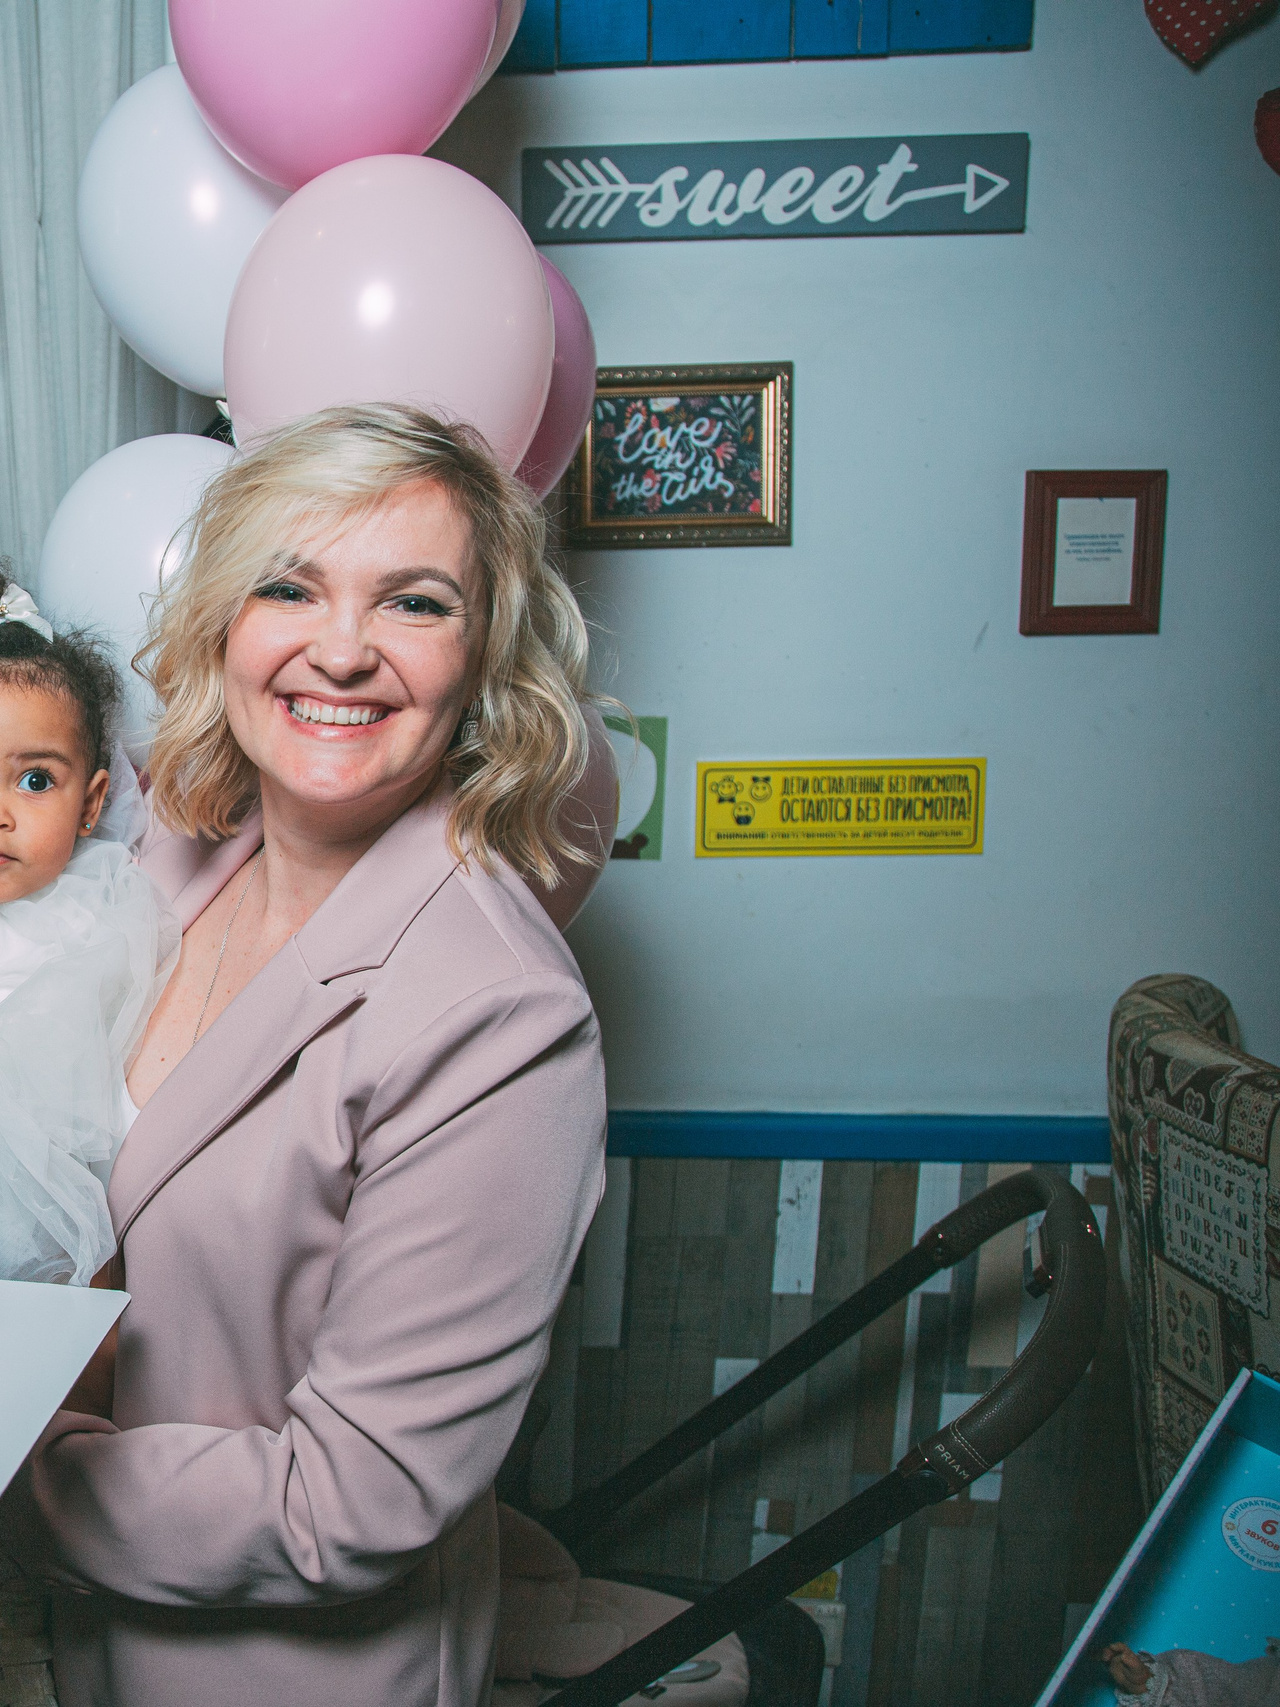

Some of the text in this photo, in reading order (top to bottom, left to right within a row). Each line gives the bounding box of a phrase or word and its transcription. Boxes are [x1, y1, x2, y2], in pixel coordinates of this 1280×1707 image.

[638, 143, 919, 228] sweet
[614, 412, 723, 463] love
[611, 472, 661, 501] the
[781, 776, 810, 795] ДЕТИ
[813, 775, 884, 793] ОСТАВЛЕННЫЕ
[888, 775, 907, 793] БЕЗ
[780, 795, 972, 822] ОСТАЮТСЯ БЕЗ ПРИСМОТРА!
[934, 1443, 971, 1481] PRIAM
[1244, 1527, 1280, 1551] ЗВУКОВ
[1261, 1519, 1279, 1536] 6
[1228, 1535, 1256, 1562] МЯГКАЯ
